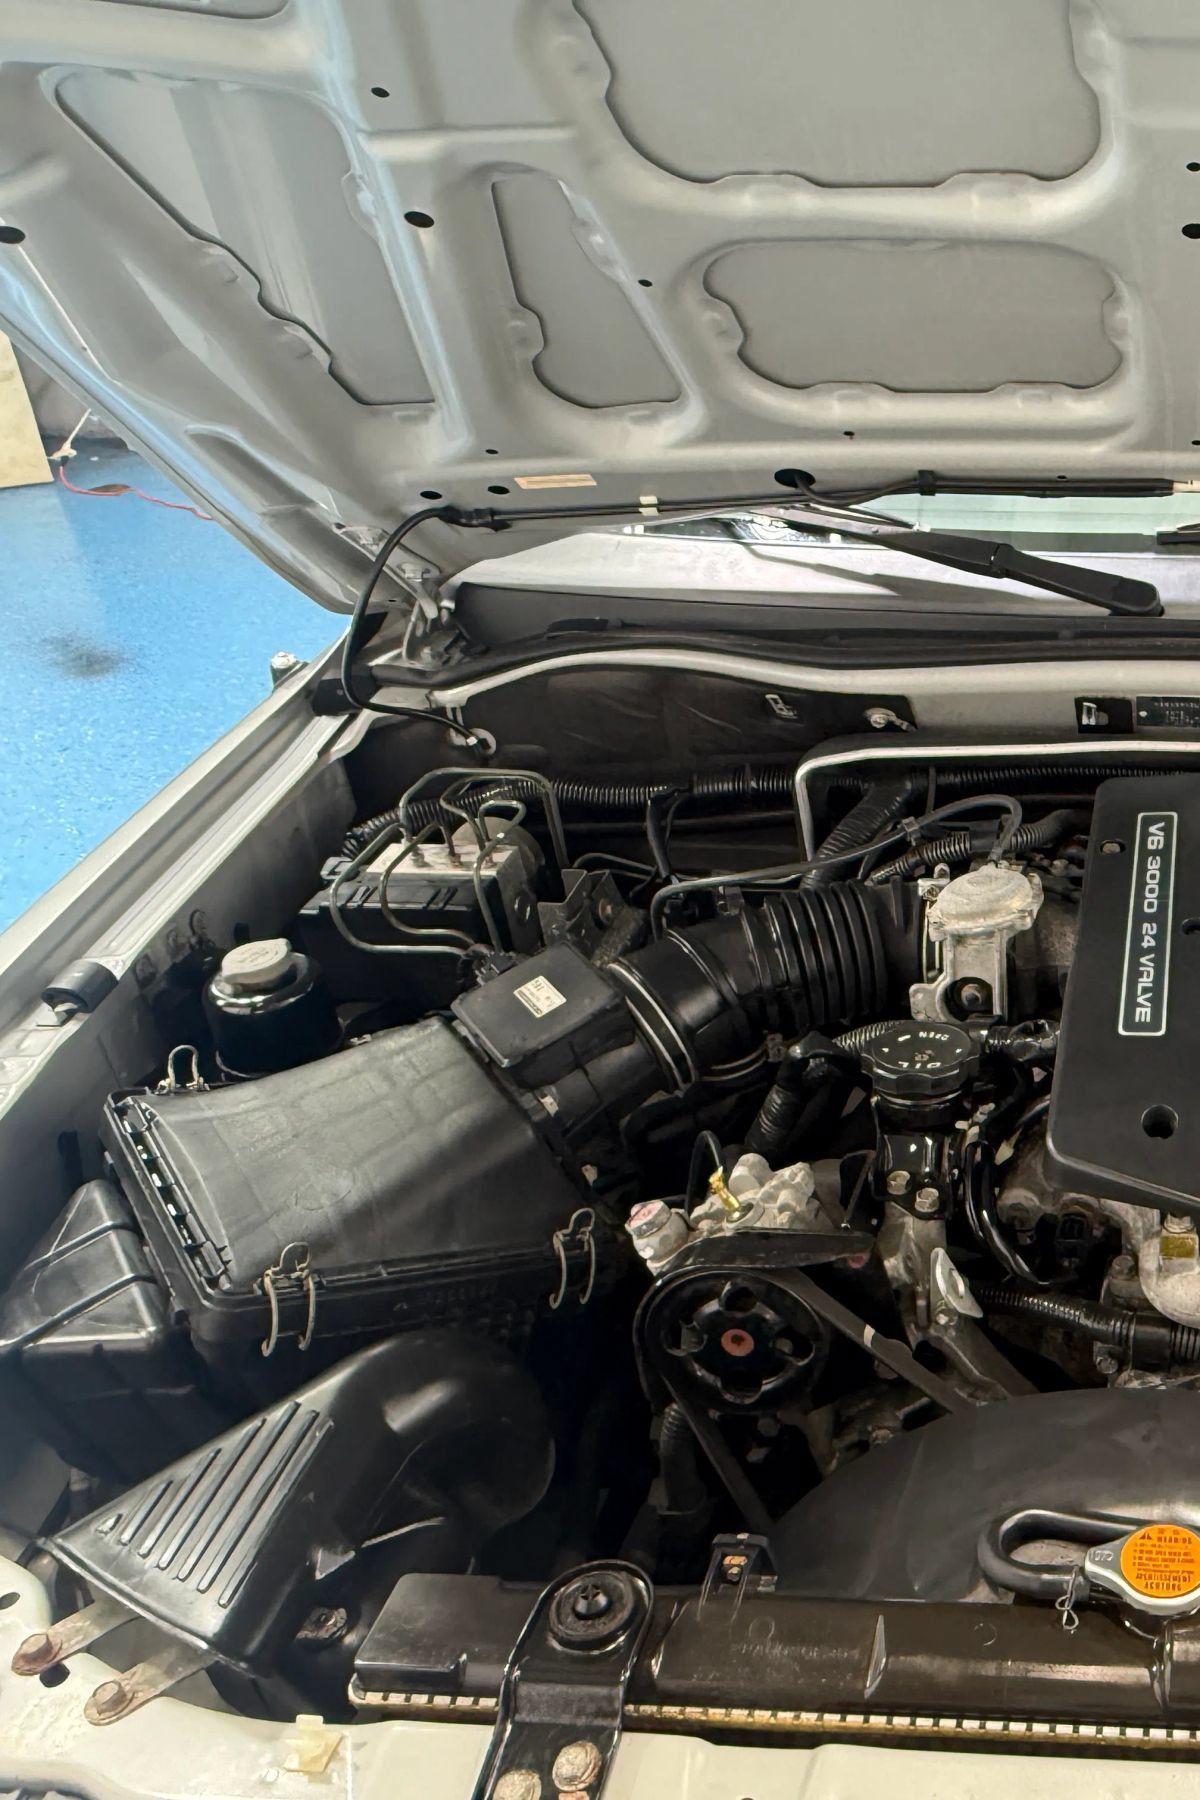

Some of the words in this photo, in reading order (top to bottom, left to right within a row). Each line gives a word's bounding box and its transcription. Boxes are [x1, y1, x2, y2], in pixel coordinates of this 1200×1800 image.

[1147, 821, 1165, 850] V6
[1143, 855, 1161, 914] 3000
[1140, 922, 1158, 949] 24
[1135, 953, 1155, 1023] VALVE
[898, 1061, 941, 1069] OIL
